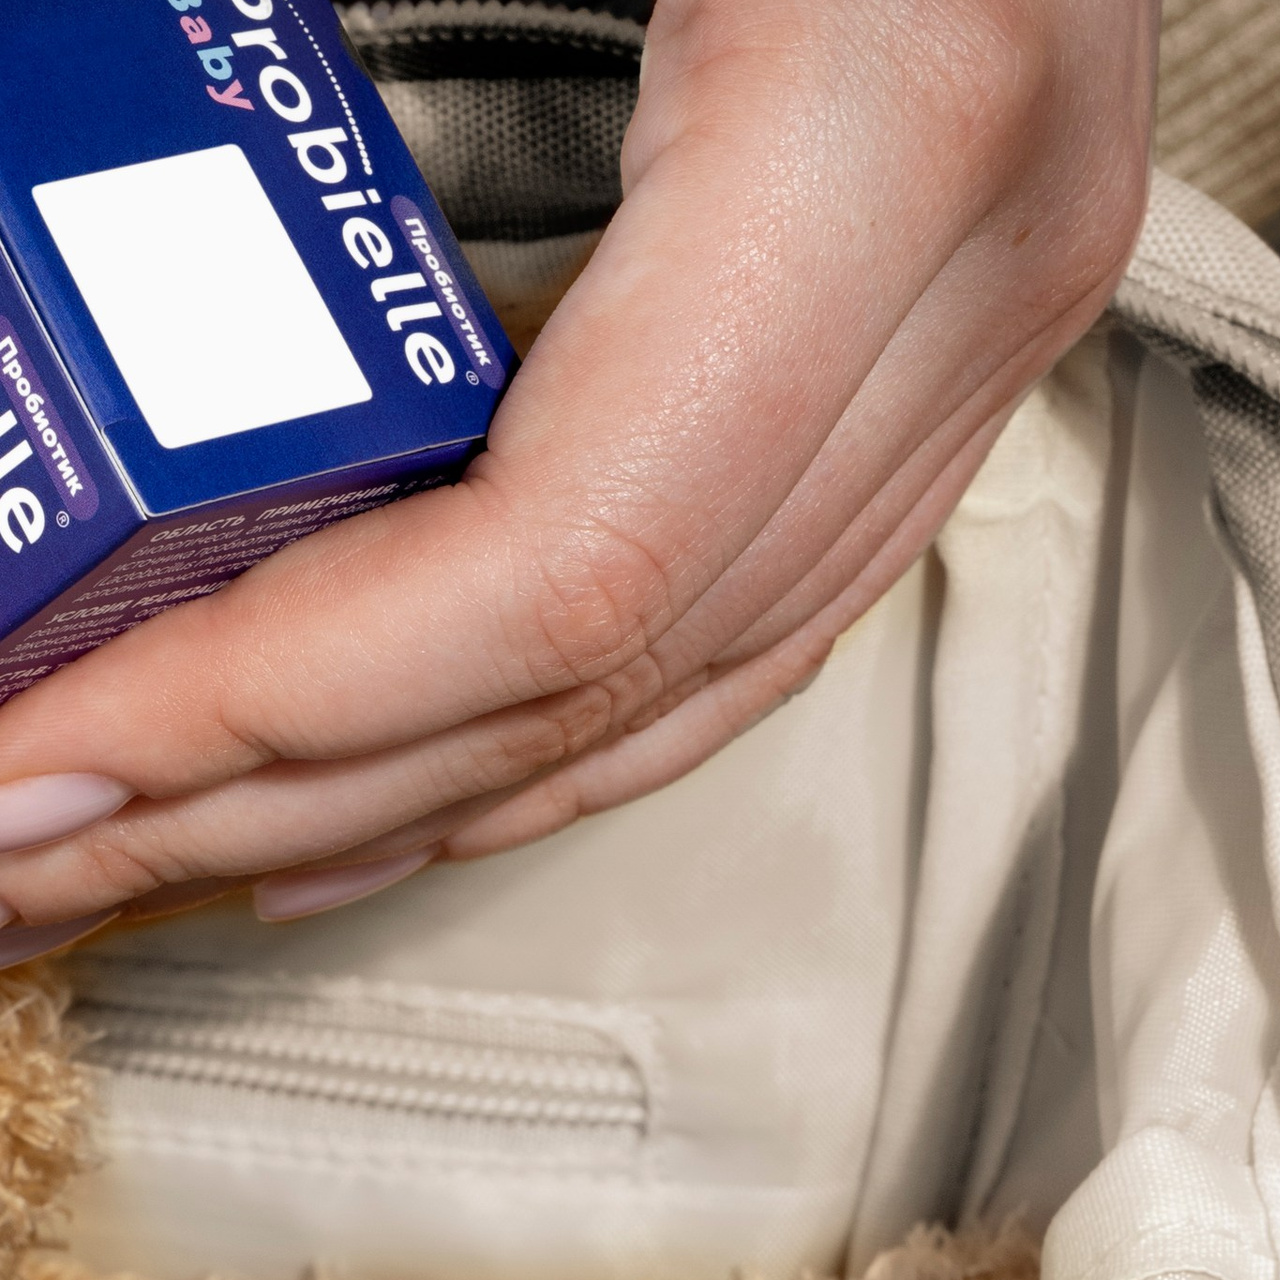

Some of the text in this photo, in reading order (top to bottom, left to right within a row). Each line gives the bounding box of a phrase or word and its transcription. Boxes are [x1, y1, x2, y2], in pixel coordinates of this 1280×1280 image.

[405, 218, 490, 365] Пробиотик
[150, 514, 246, 543] ОБЛАСТЬ
[256, 483, 400, 521] ПРИМЕНЕНИЯ:
[131, 528, 245, 558] биологически
[246, 510, 322, 535] активной
[111, 549, 196, 573] источника
[24, 614, 124, 642] реализации
[45, 599, 134, 625] УСЛОВИЯ
